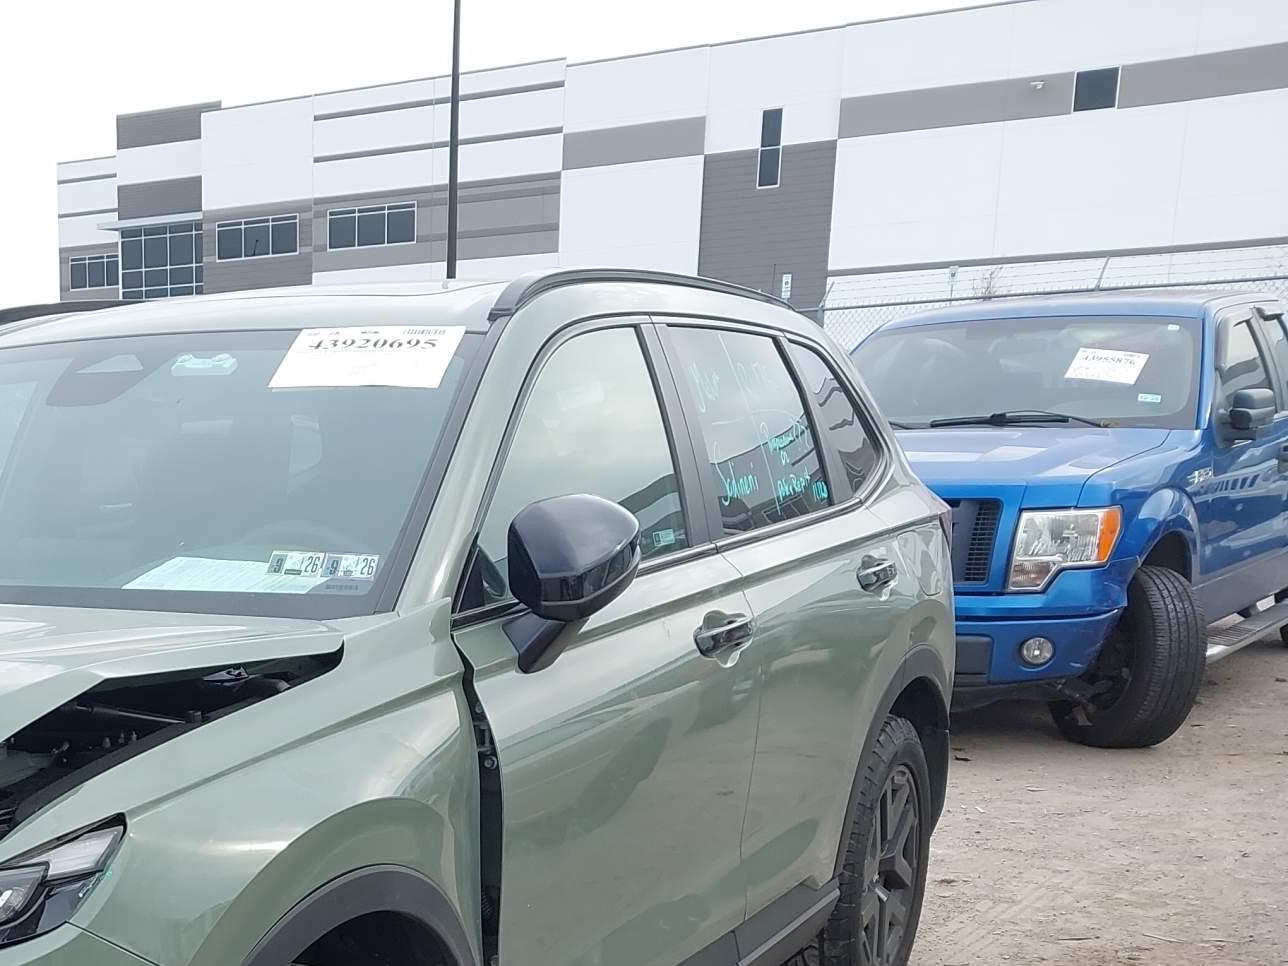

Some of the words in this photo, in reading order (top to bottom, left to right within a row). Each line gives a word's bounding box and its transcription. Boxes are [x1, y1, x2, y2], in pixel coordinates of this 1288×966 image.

[308, 338, 439, 350] 43920695
[304, 556, 320, 574] 26
[329, 559, 339, 575] 9
[360, 558, 376, 576] 26
